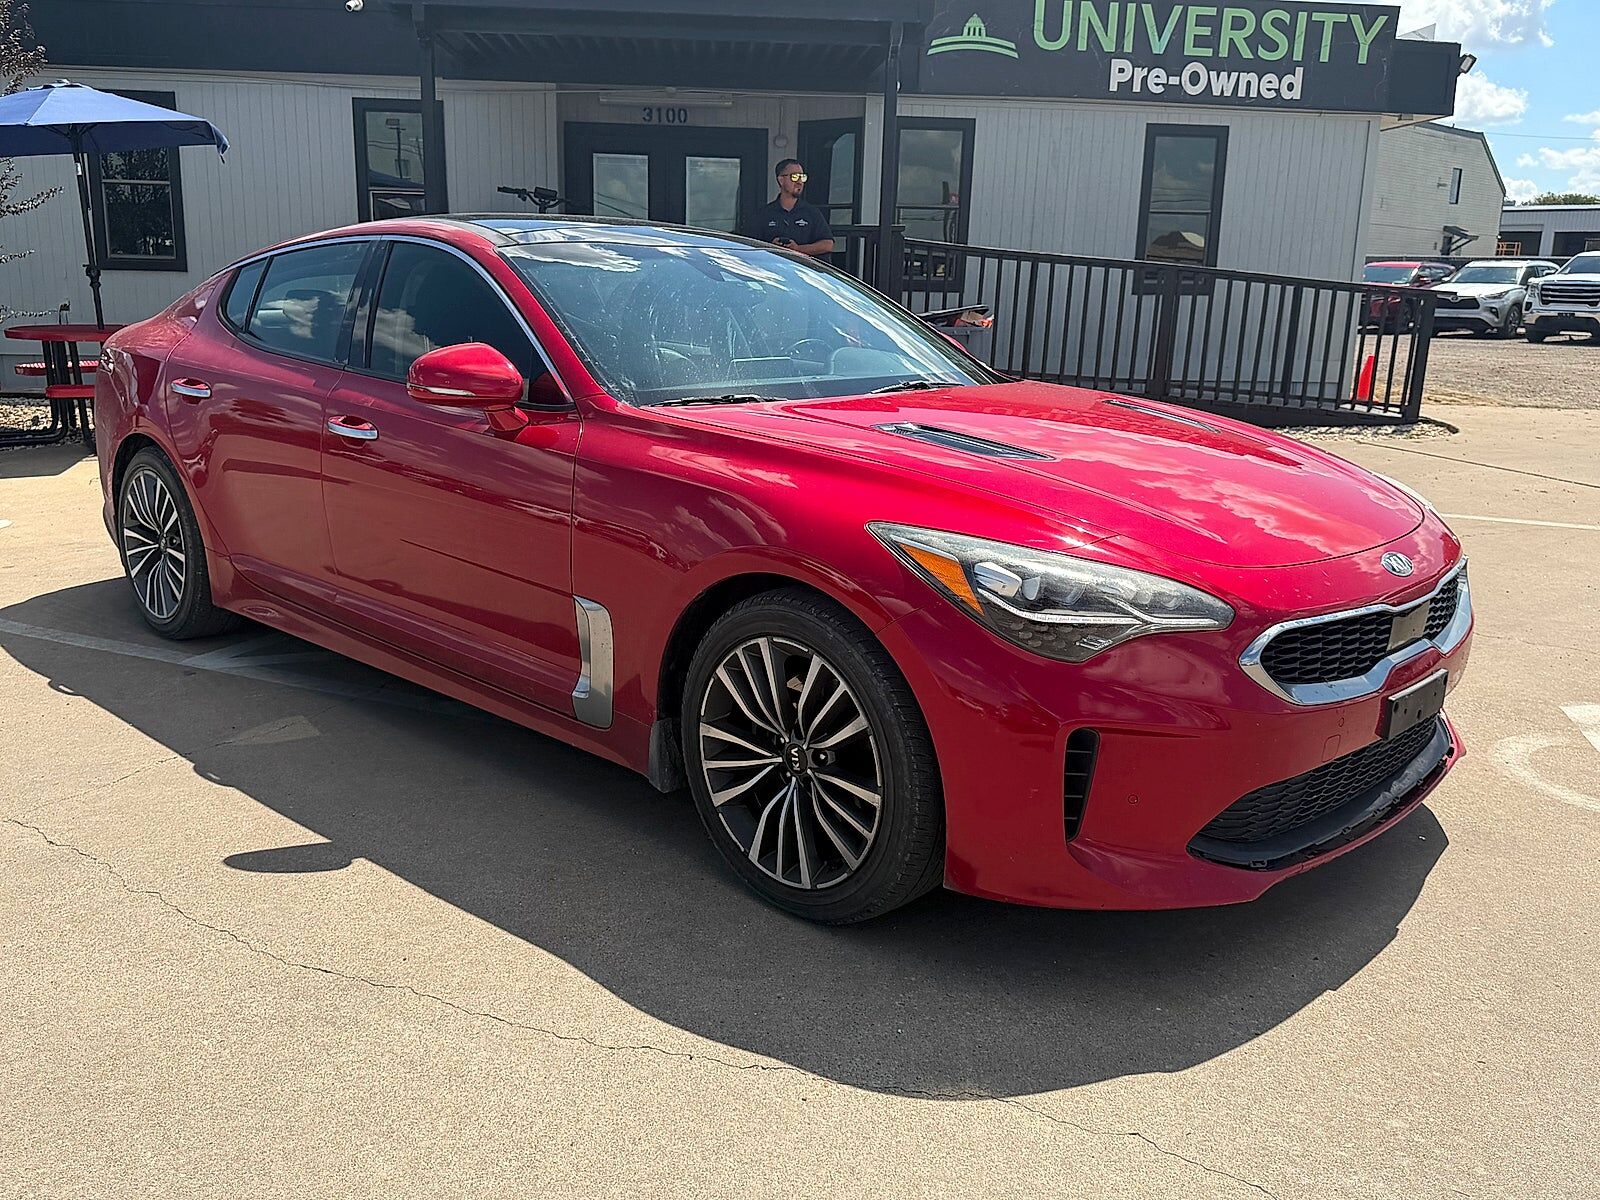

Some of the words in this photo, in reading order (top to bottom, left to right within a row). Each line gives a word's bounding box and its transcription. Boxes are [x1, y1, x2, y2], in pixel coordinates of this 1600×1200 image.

[1033, 0, 1388, 64] UNIVERSITY
[1109, 58, 1303, 100] Pre-Owned
[642, 107, 688, 123] 3100
[791, 747, 800, 770] KIA
